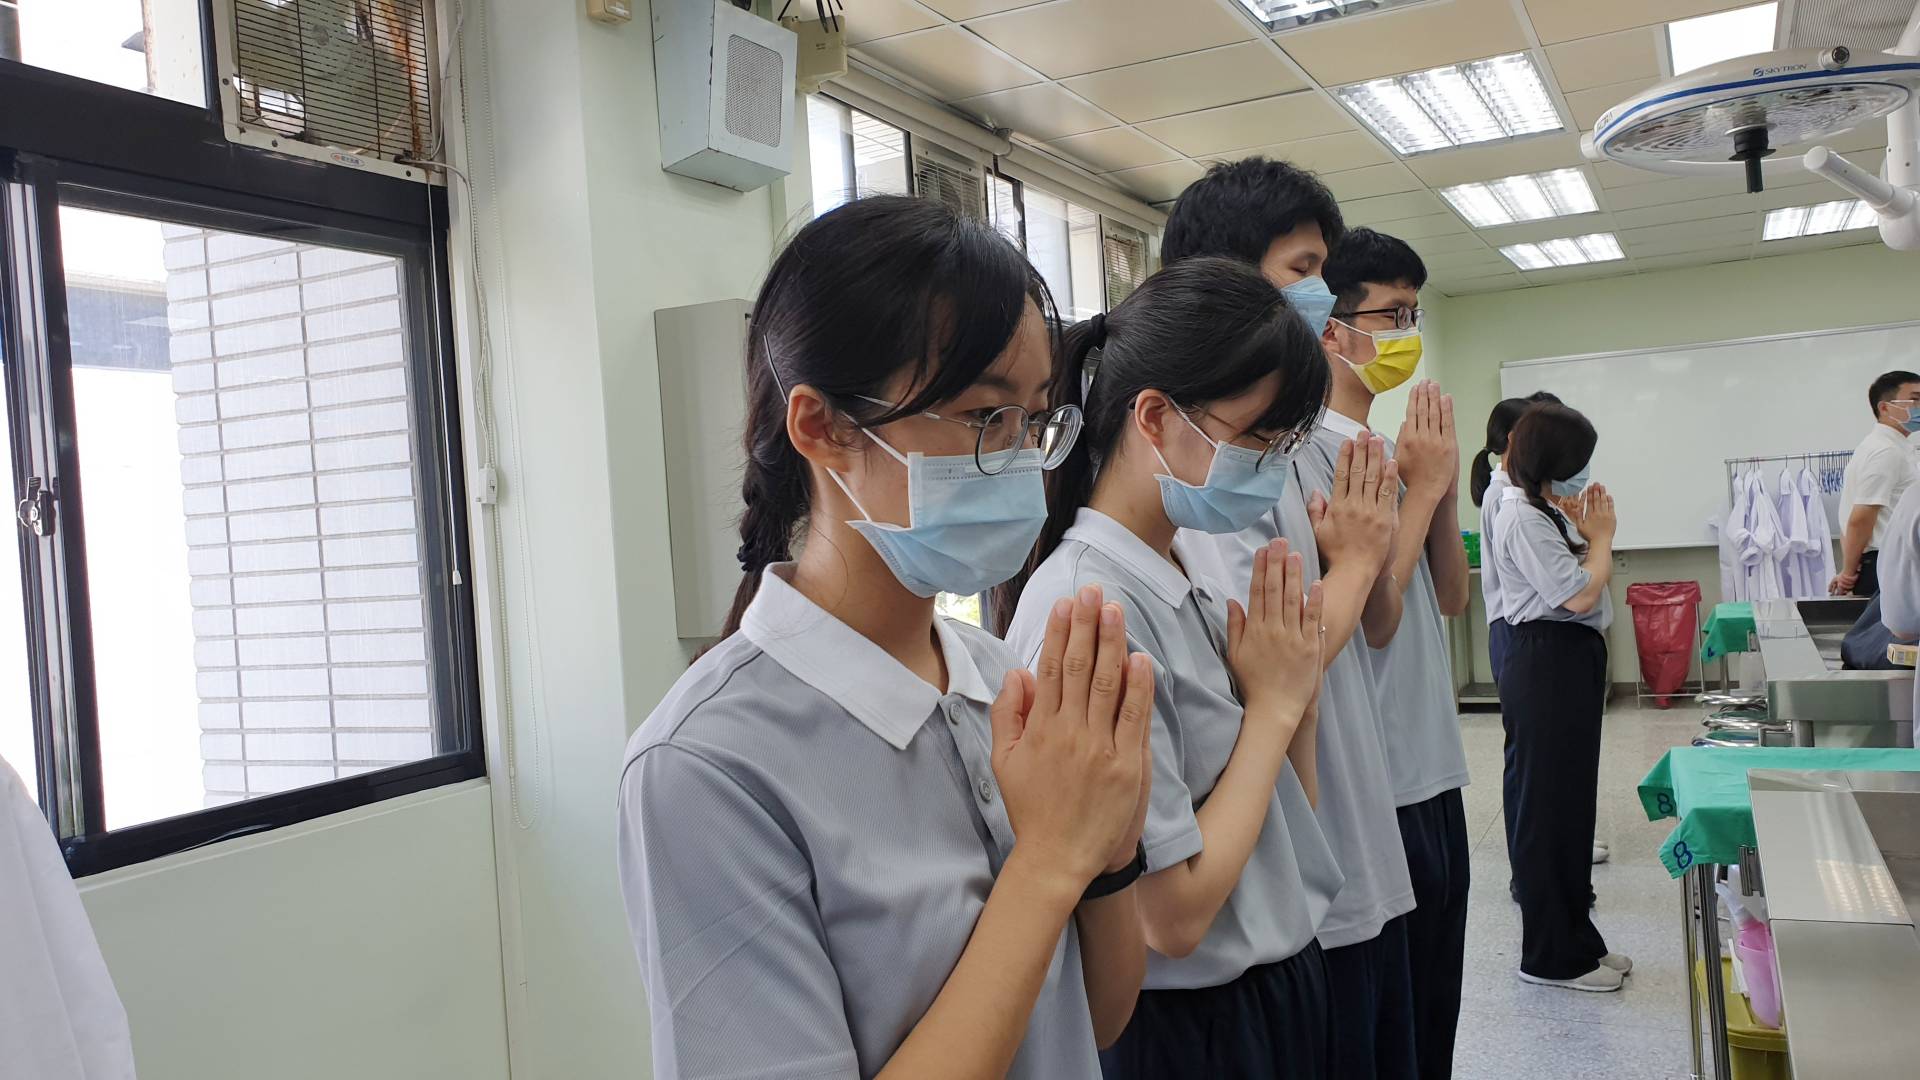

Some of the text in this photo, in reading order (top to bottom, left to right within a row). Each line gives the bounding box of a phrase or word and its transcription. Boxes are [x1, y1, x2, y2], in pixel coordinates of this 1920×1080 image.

[1764, 64, 1806, 75] SKYTRON
[1657, 793, 1673, 814] 8
[1673, 841, 1692, 868] 8
